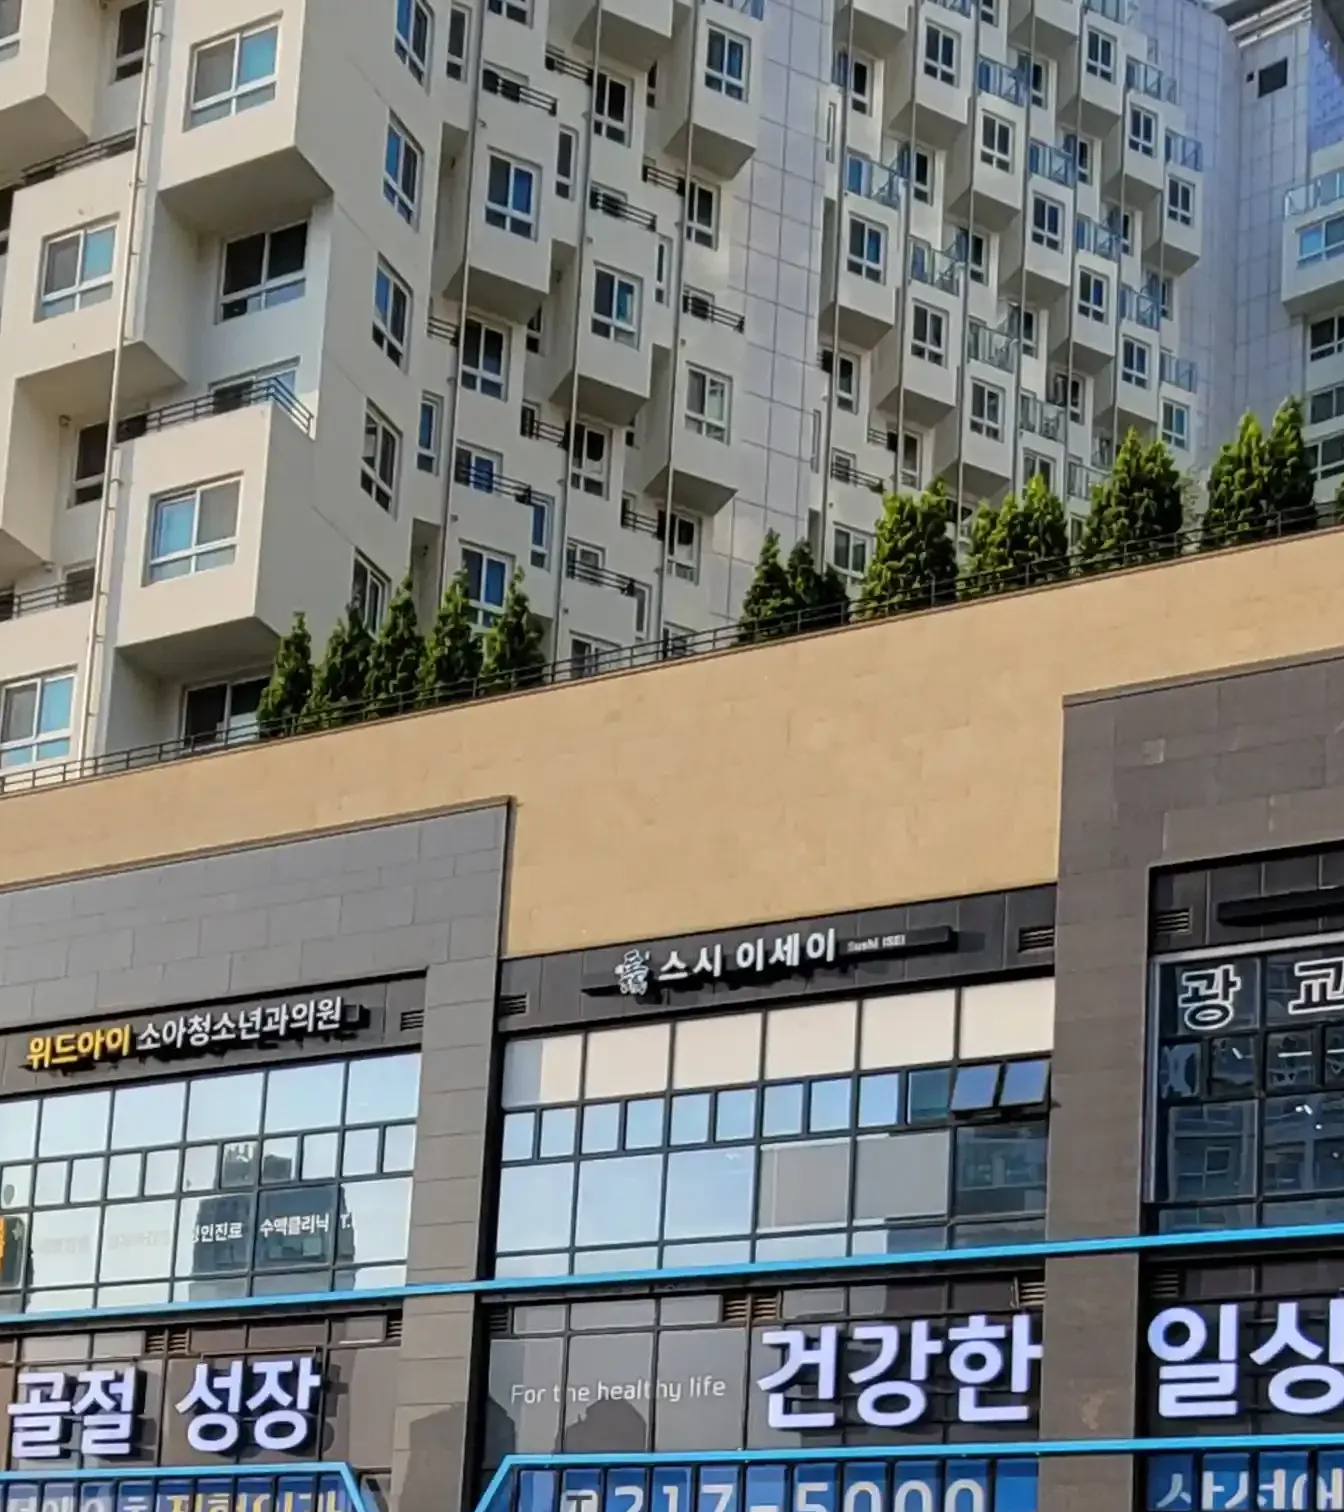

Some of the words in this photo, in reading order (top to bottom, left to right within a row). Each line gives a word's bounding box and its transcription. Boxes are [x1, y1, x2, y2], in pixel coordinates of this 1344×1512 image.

[658, 944, 722, 982] 스시
[735, 928, 835, 972] 이세이
[27, 1025, 131, 1070] 위드아이
[136, 997, 343, 1050] 소아청소년과의원
[511, 1383, 546, 1404] For
[689, 1376, 727, 1397] life
[758, 1314, 1044, 1428] 건강한
[8, 1368, 134, 1458] 골절
[176, 1358, 320, 1451] 성장
